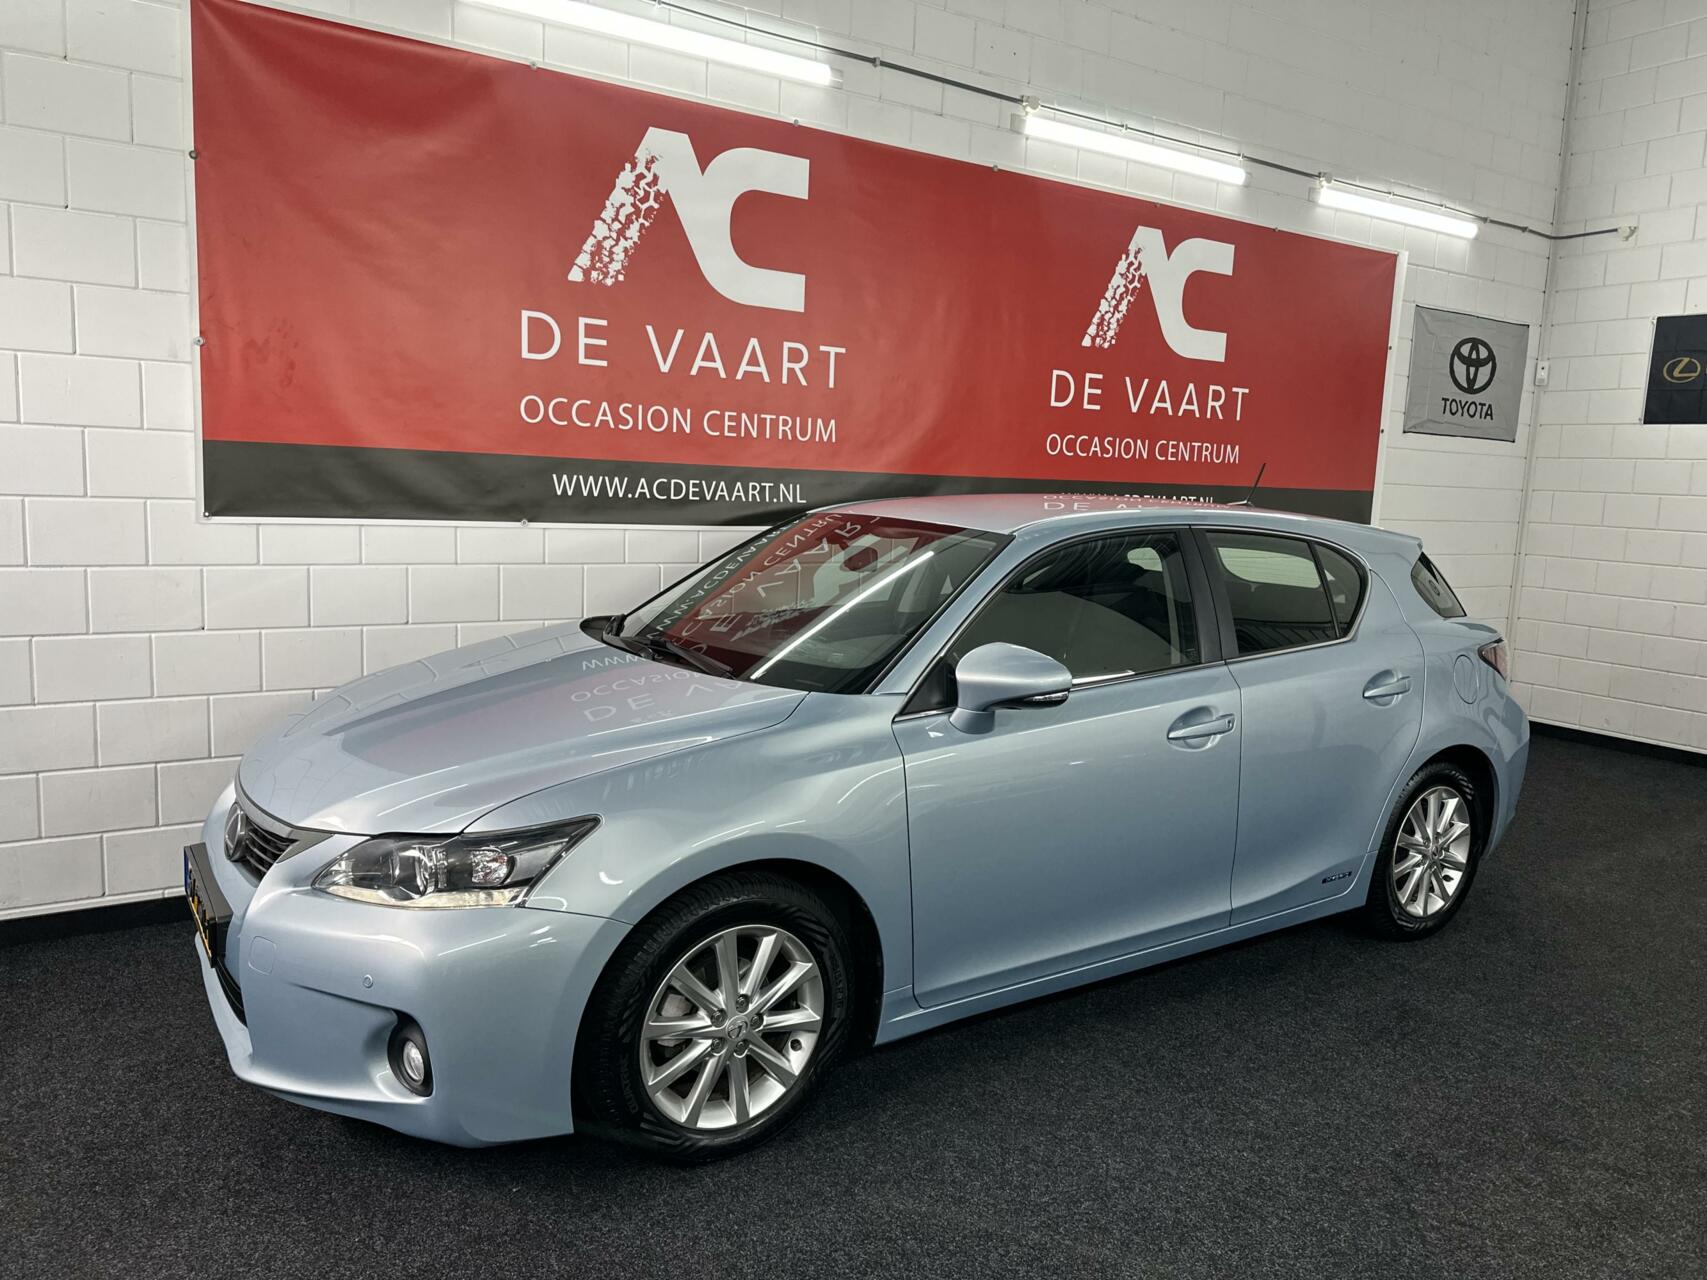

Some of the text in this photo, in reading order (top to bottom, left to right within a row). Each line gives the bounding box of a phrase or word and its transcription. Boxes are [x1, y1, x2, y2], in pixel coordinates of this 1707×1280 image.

[567, 126, 810, 313] AC
[1081, 225, 1235, 363] AC
[520, 309, 847, 389] DE VAART
[519, 395, 837, 443] OCCASION CENTRUM
[1050, 369, 1250, 421] DE VAART
[1441, 397, 1494, 421] TOYOTA
[1046, 433, 1240, 464] OCCASION CENTRUM
[552, 473, 807, 504] WWW.ACDEVAART.NL
